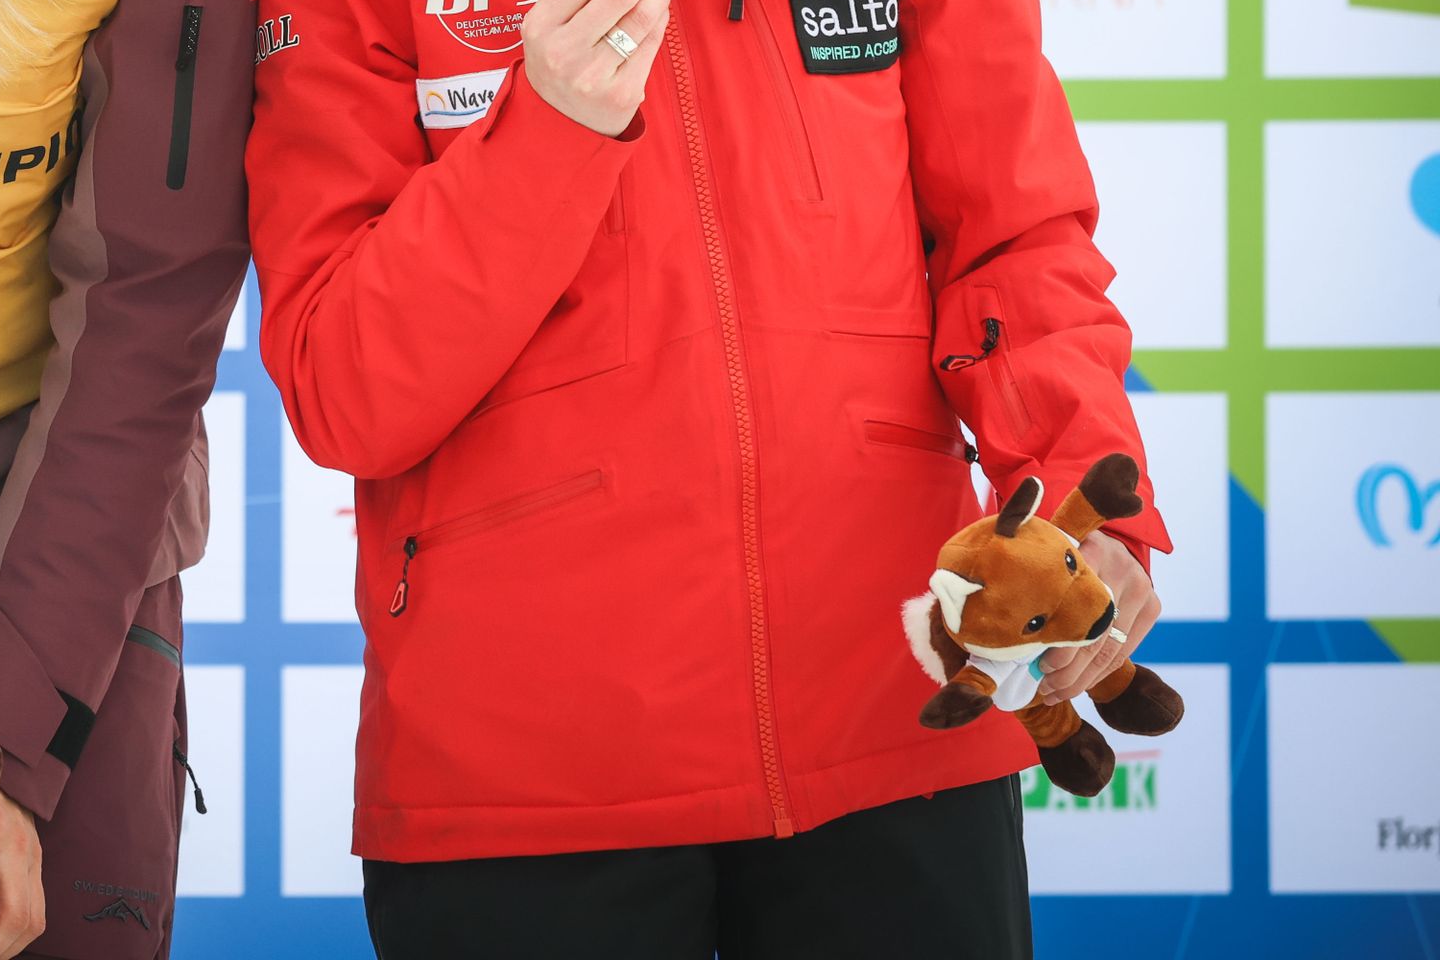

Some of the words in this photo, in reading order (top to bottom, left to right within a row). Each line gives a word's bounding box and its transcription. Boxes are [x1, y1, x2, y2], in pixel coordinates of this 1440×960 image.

[456, 15, 505, 29] DEUTSCHES
[507, 13, 529, 22] PAR
[254, 14, 300, 65] OLL
[464, 26, 502, 38] SKITEAM
[811, 45, 861, 60] INSPIRED
[447, 88, 495, 110] Wave
